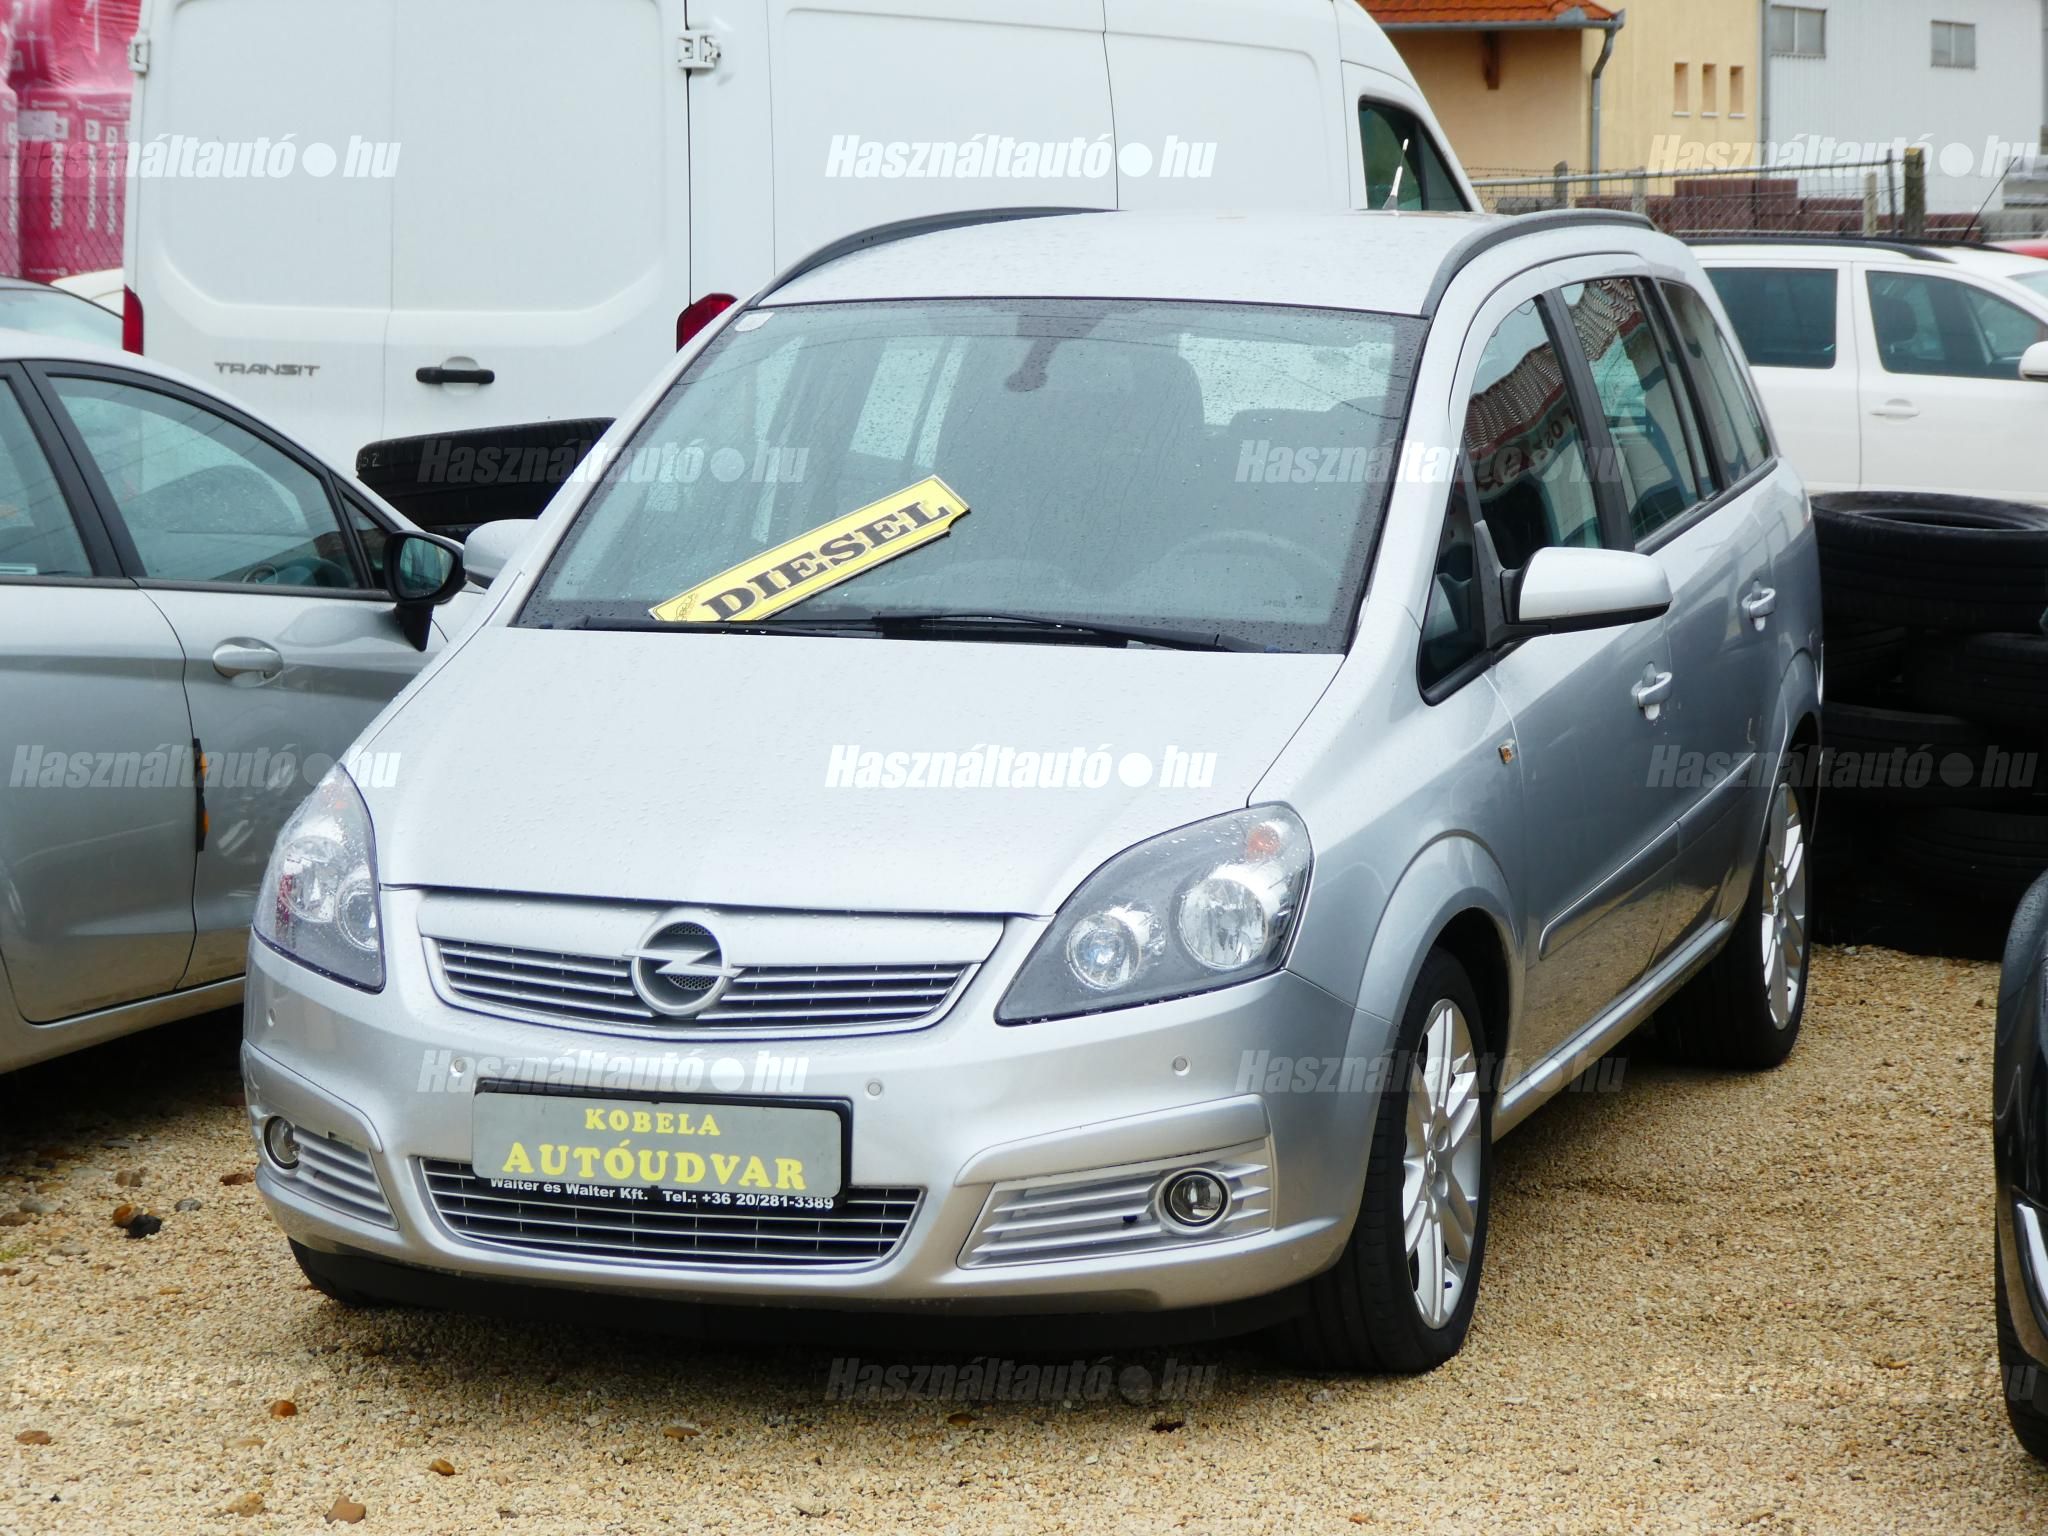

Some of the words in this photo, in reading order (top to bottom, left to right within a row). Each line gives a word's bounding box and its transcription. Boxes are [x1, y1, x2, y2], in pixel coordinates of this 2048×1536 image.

[215, 361, 320, 376] TRANSIT
[701, 501, 951, 621] DIESEL
[585, 1108, 721, 1136] KOBELA
[502, 1140, 807, 1190] AUTÓUDVAR
[490, 1177, 540, 1192] Walter
[566, 1183, 616, 1198] Walter
[619, 1187, 649, 1201] Kft.
[662, 1190, 697, 1203] Tel.:
[702, 1193, 731, 1205] +36
[736, 1194, 834, 1209] 20/281-3389
